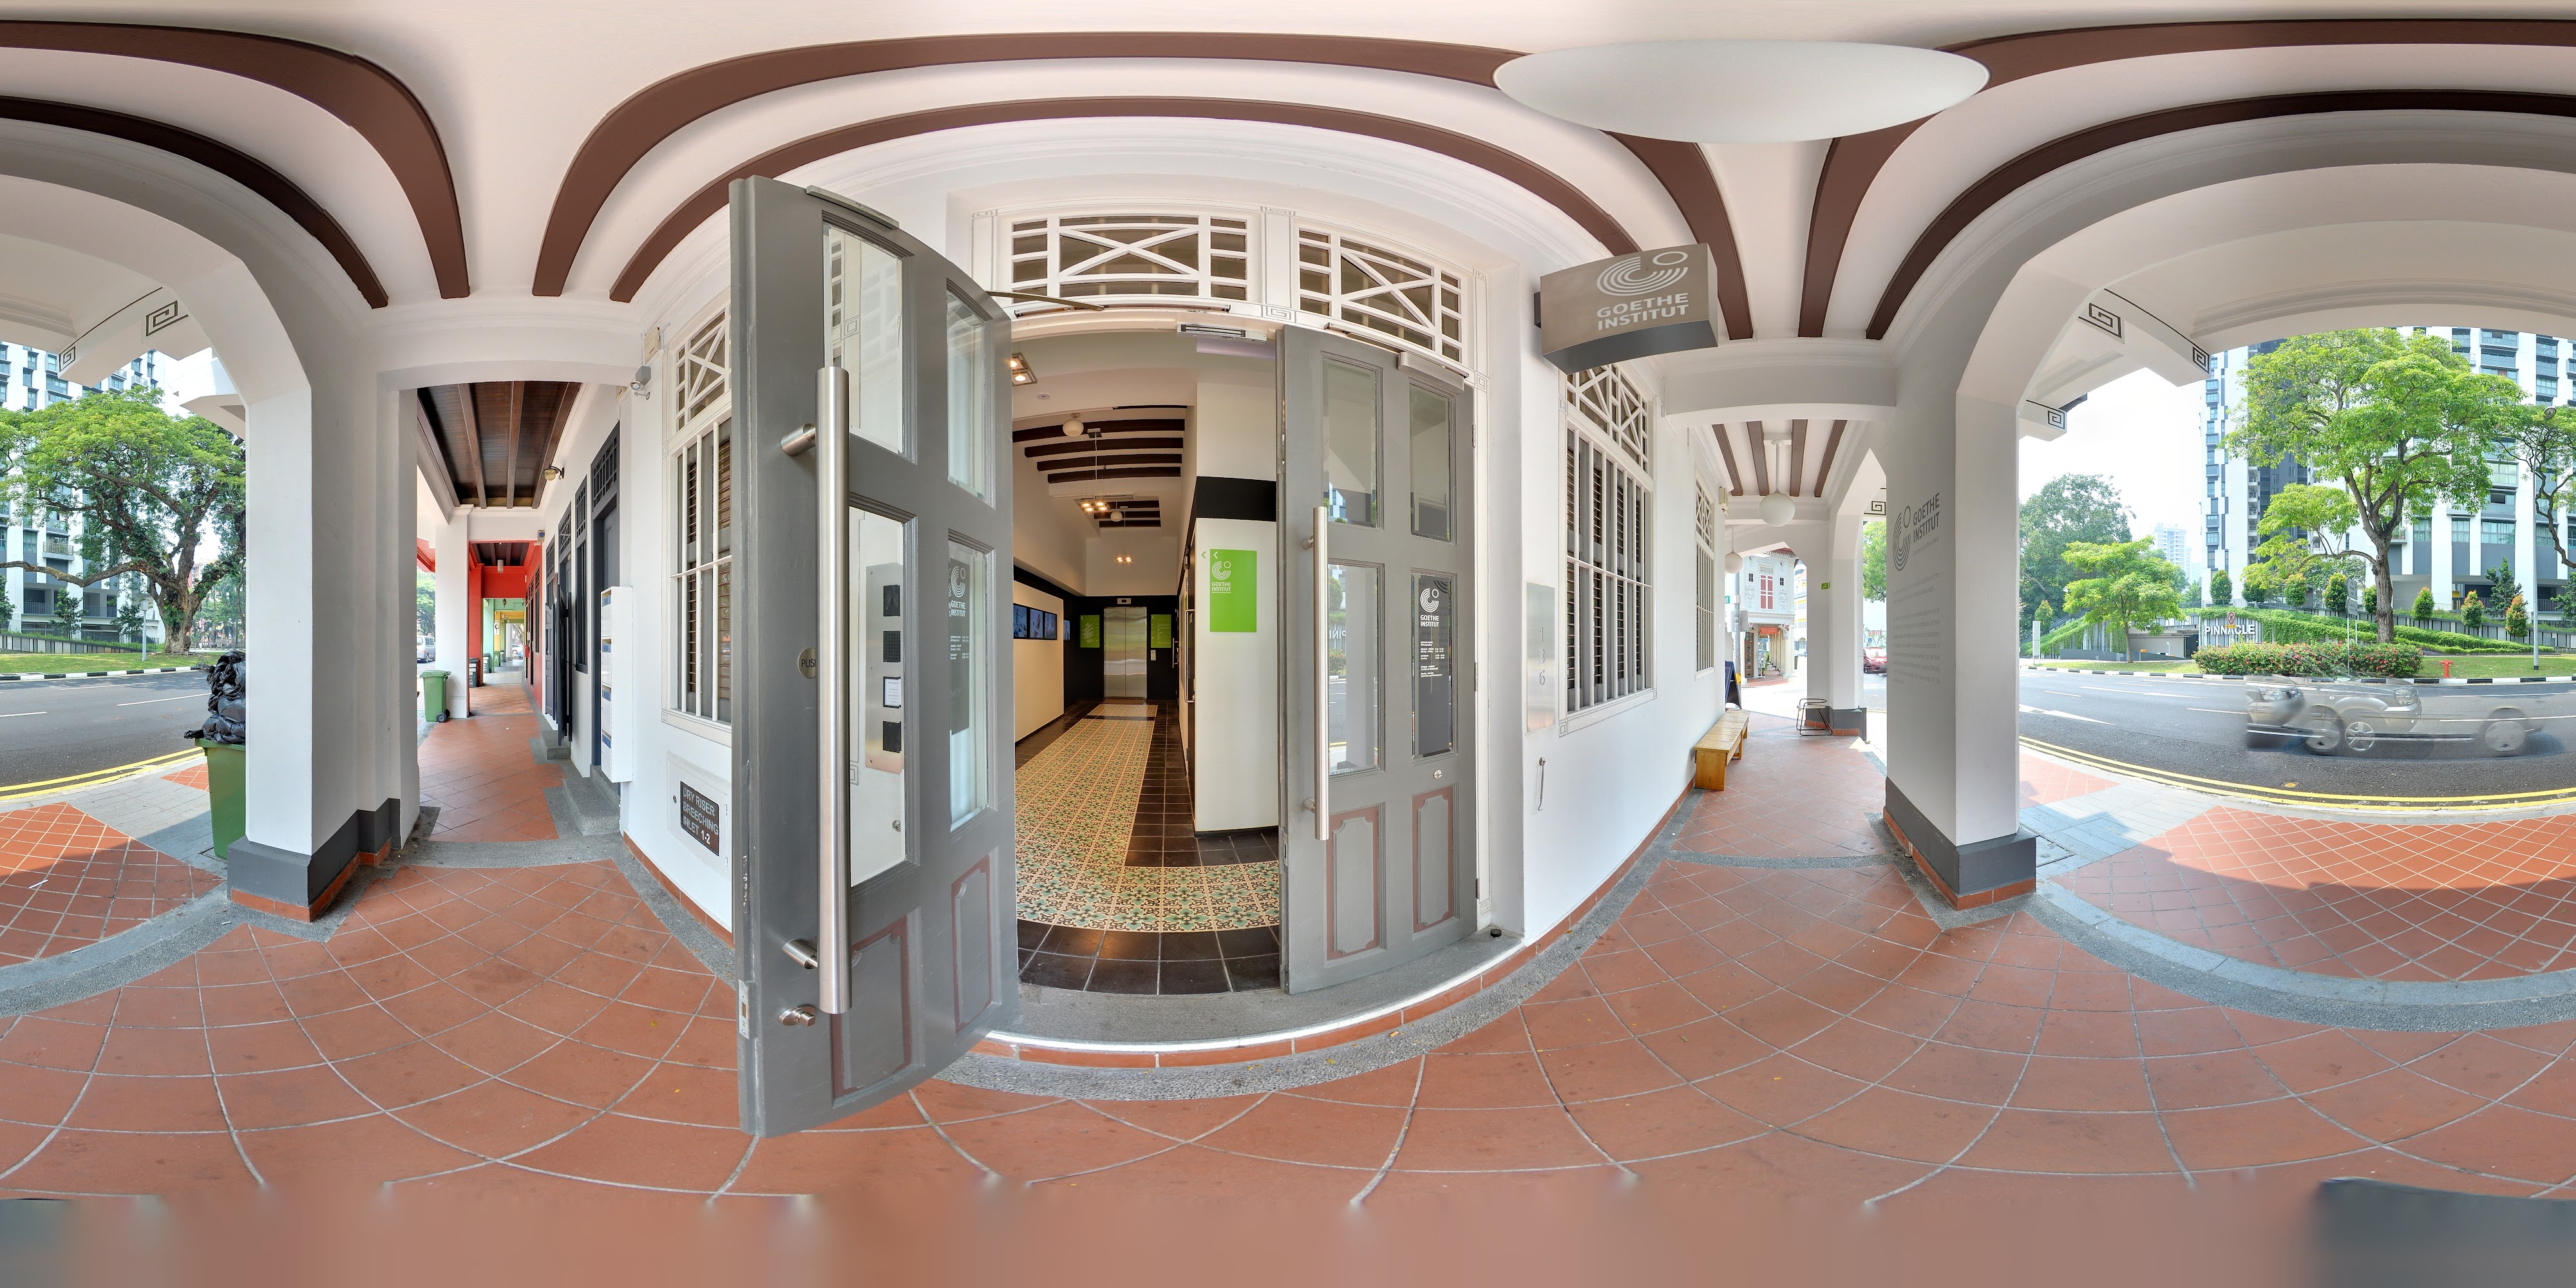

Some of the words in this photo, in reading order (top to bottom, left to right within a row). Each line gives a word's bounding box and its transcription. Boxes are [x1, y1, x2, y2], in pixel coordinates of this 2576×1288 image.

[1596, 292, 1689, 318] GOETHE
[1598, 304, 1690, 330] INSTITUT
[1913, 492, 1940, 526] GOETHE
[1913, 511, 1940, 543] INSTITUT
[951, 600, 965, 609] GOETHE
[951, 609, 965, 617] INSTITUT
[2204, 624, 2255, 636] PINNACLE
[801, 659, 816, 667] PUS
[683, 787, 695, 803] DRY
[696, 795, 715, 817] RISER
[683, 801, 719, 835] BREECHING
[683, 815, 699, 835] INLET
[701, 829, 710, 844] 1-2
